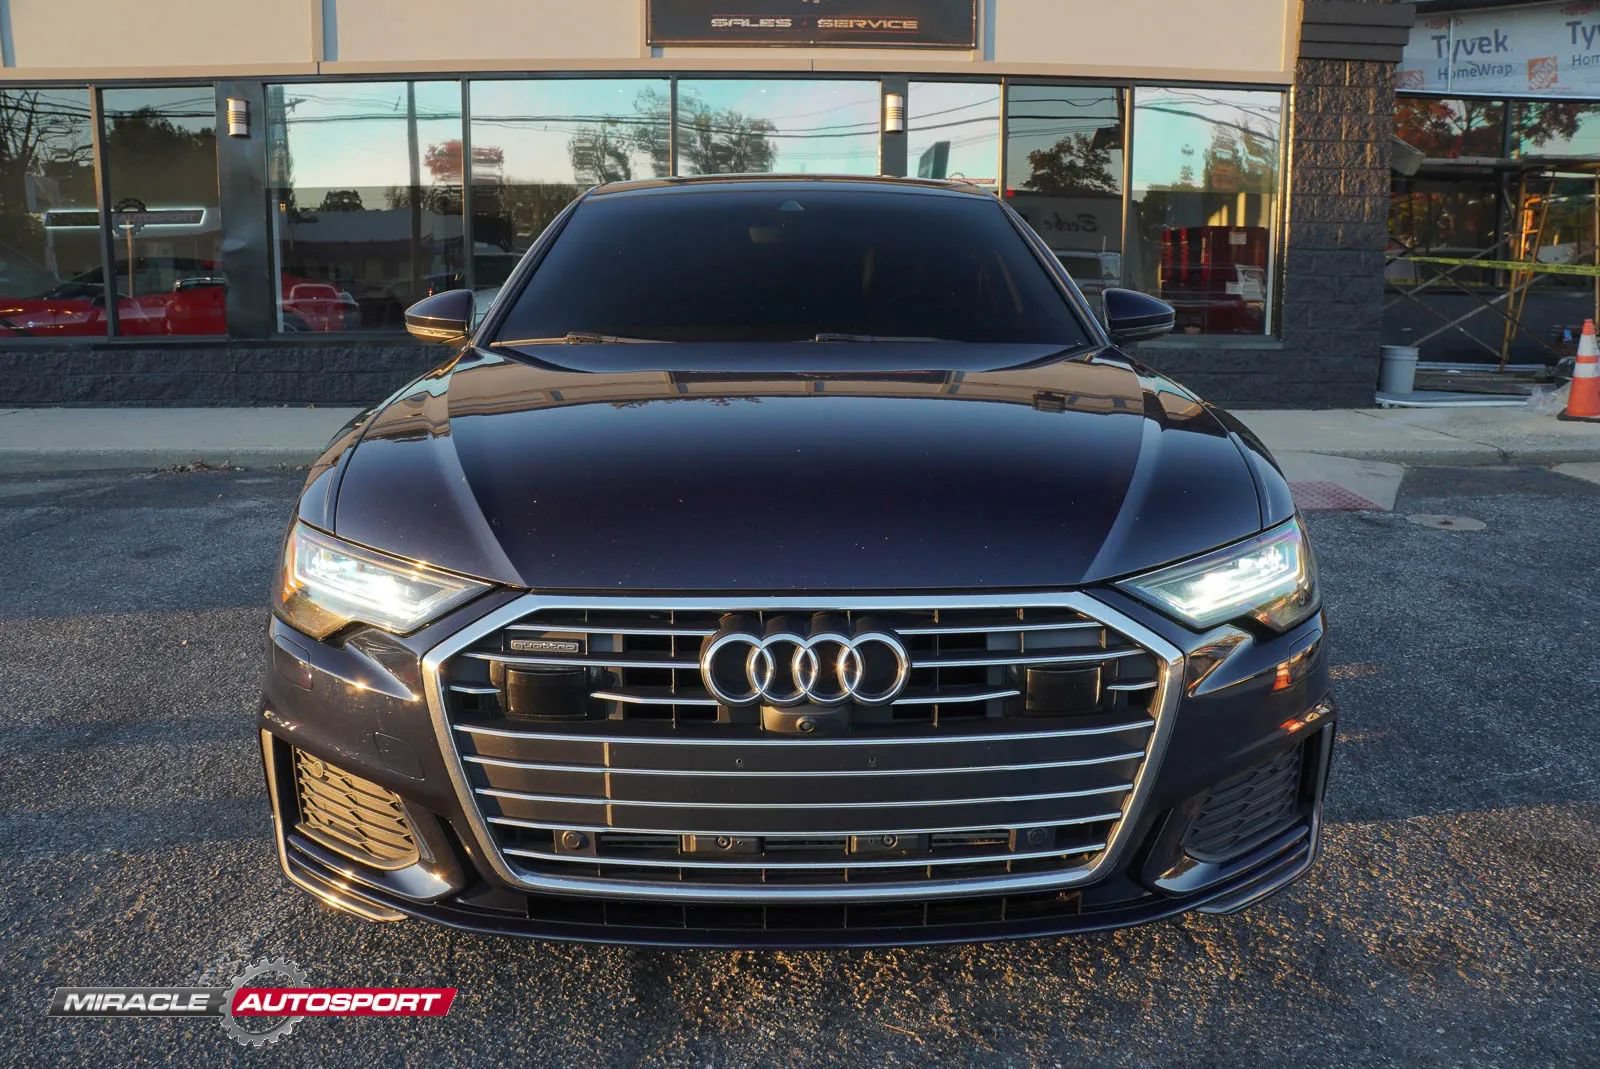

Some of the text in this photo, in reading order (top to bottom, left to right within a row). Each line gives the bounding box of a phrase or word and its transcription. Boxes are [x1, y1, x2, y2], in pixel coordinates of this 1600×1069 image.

[711, 17, 918, 29] SALES SERVICE
[1565, 20, 1600, 50] Ty
[1431, 28, 1509, 63] Tyvek
[1438, 62, 1513, 80] HomeWrap
[513, 641, 576, 651] quattro
